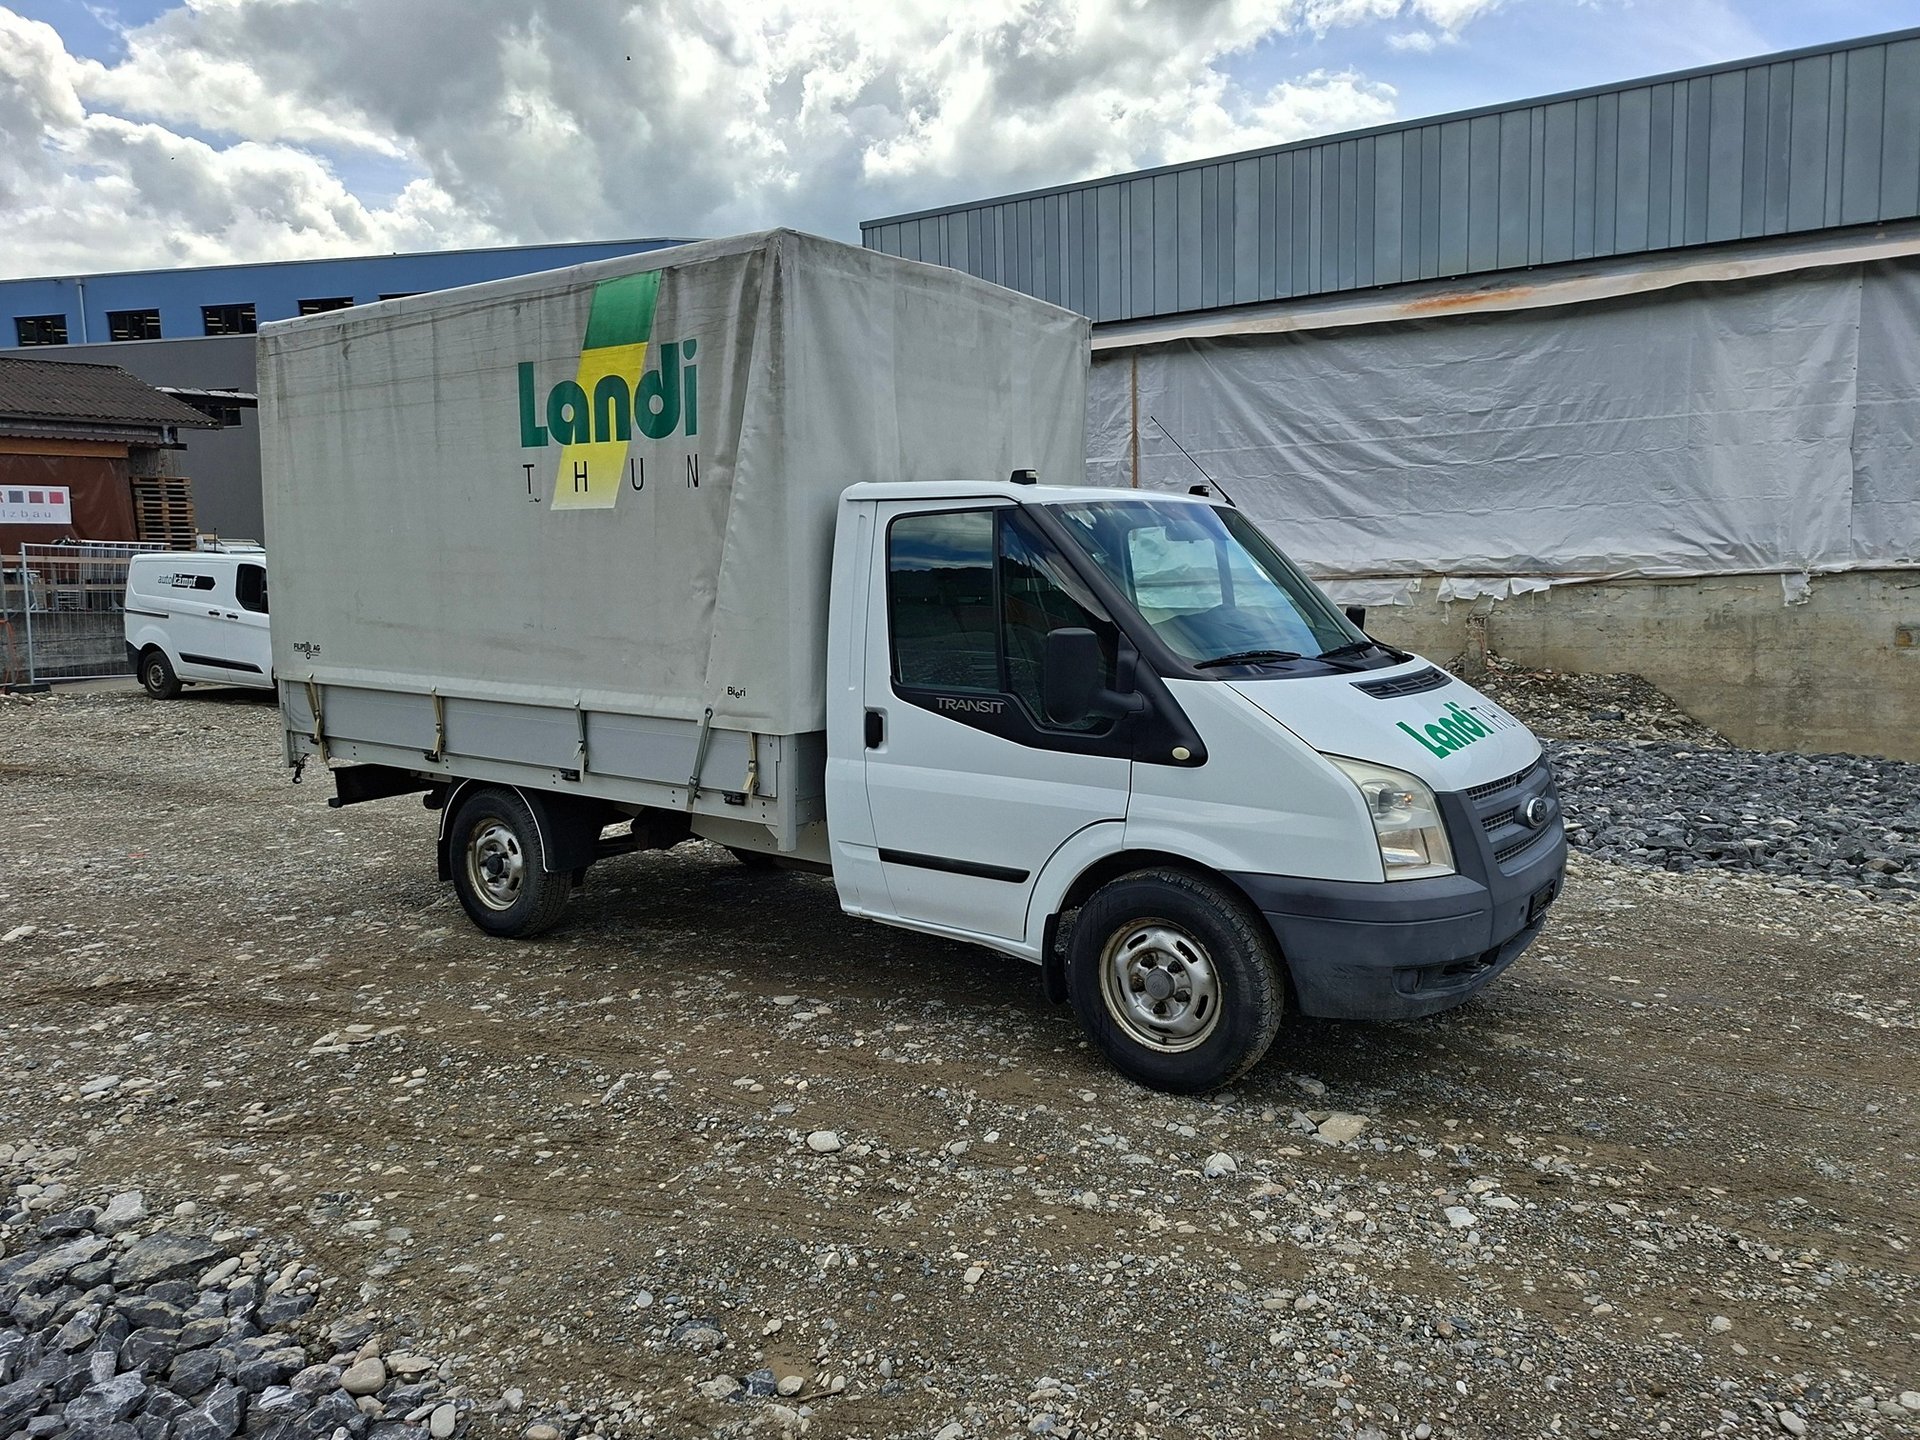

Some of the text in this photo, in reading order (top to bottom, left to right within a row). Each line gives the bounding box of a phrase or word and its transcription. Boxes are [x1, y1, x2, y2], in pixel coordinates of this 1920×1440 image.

[517, 338, 698, 448] Landi
[522, 453, 700, 495] THUN
[936, 697, 1004, 714] TRANSIT
[1395, 701, 1495, 760] Landi
